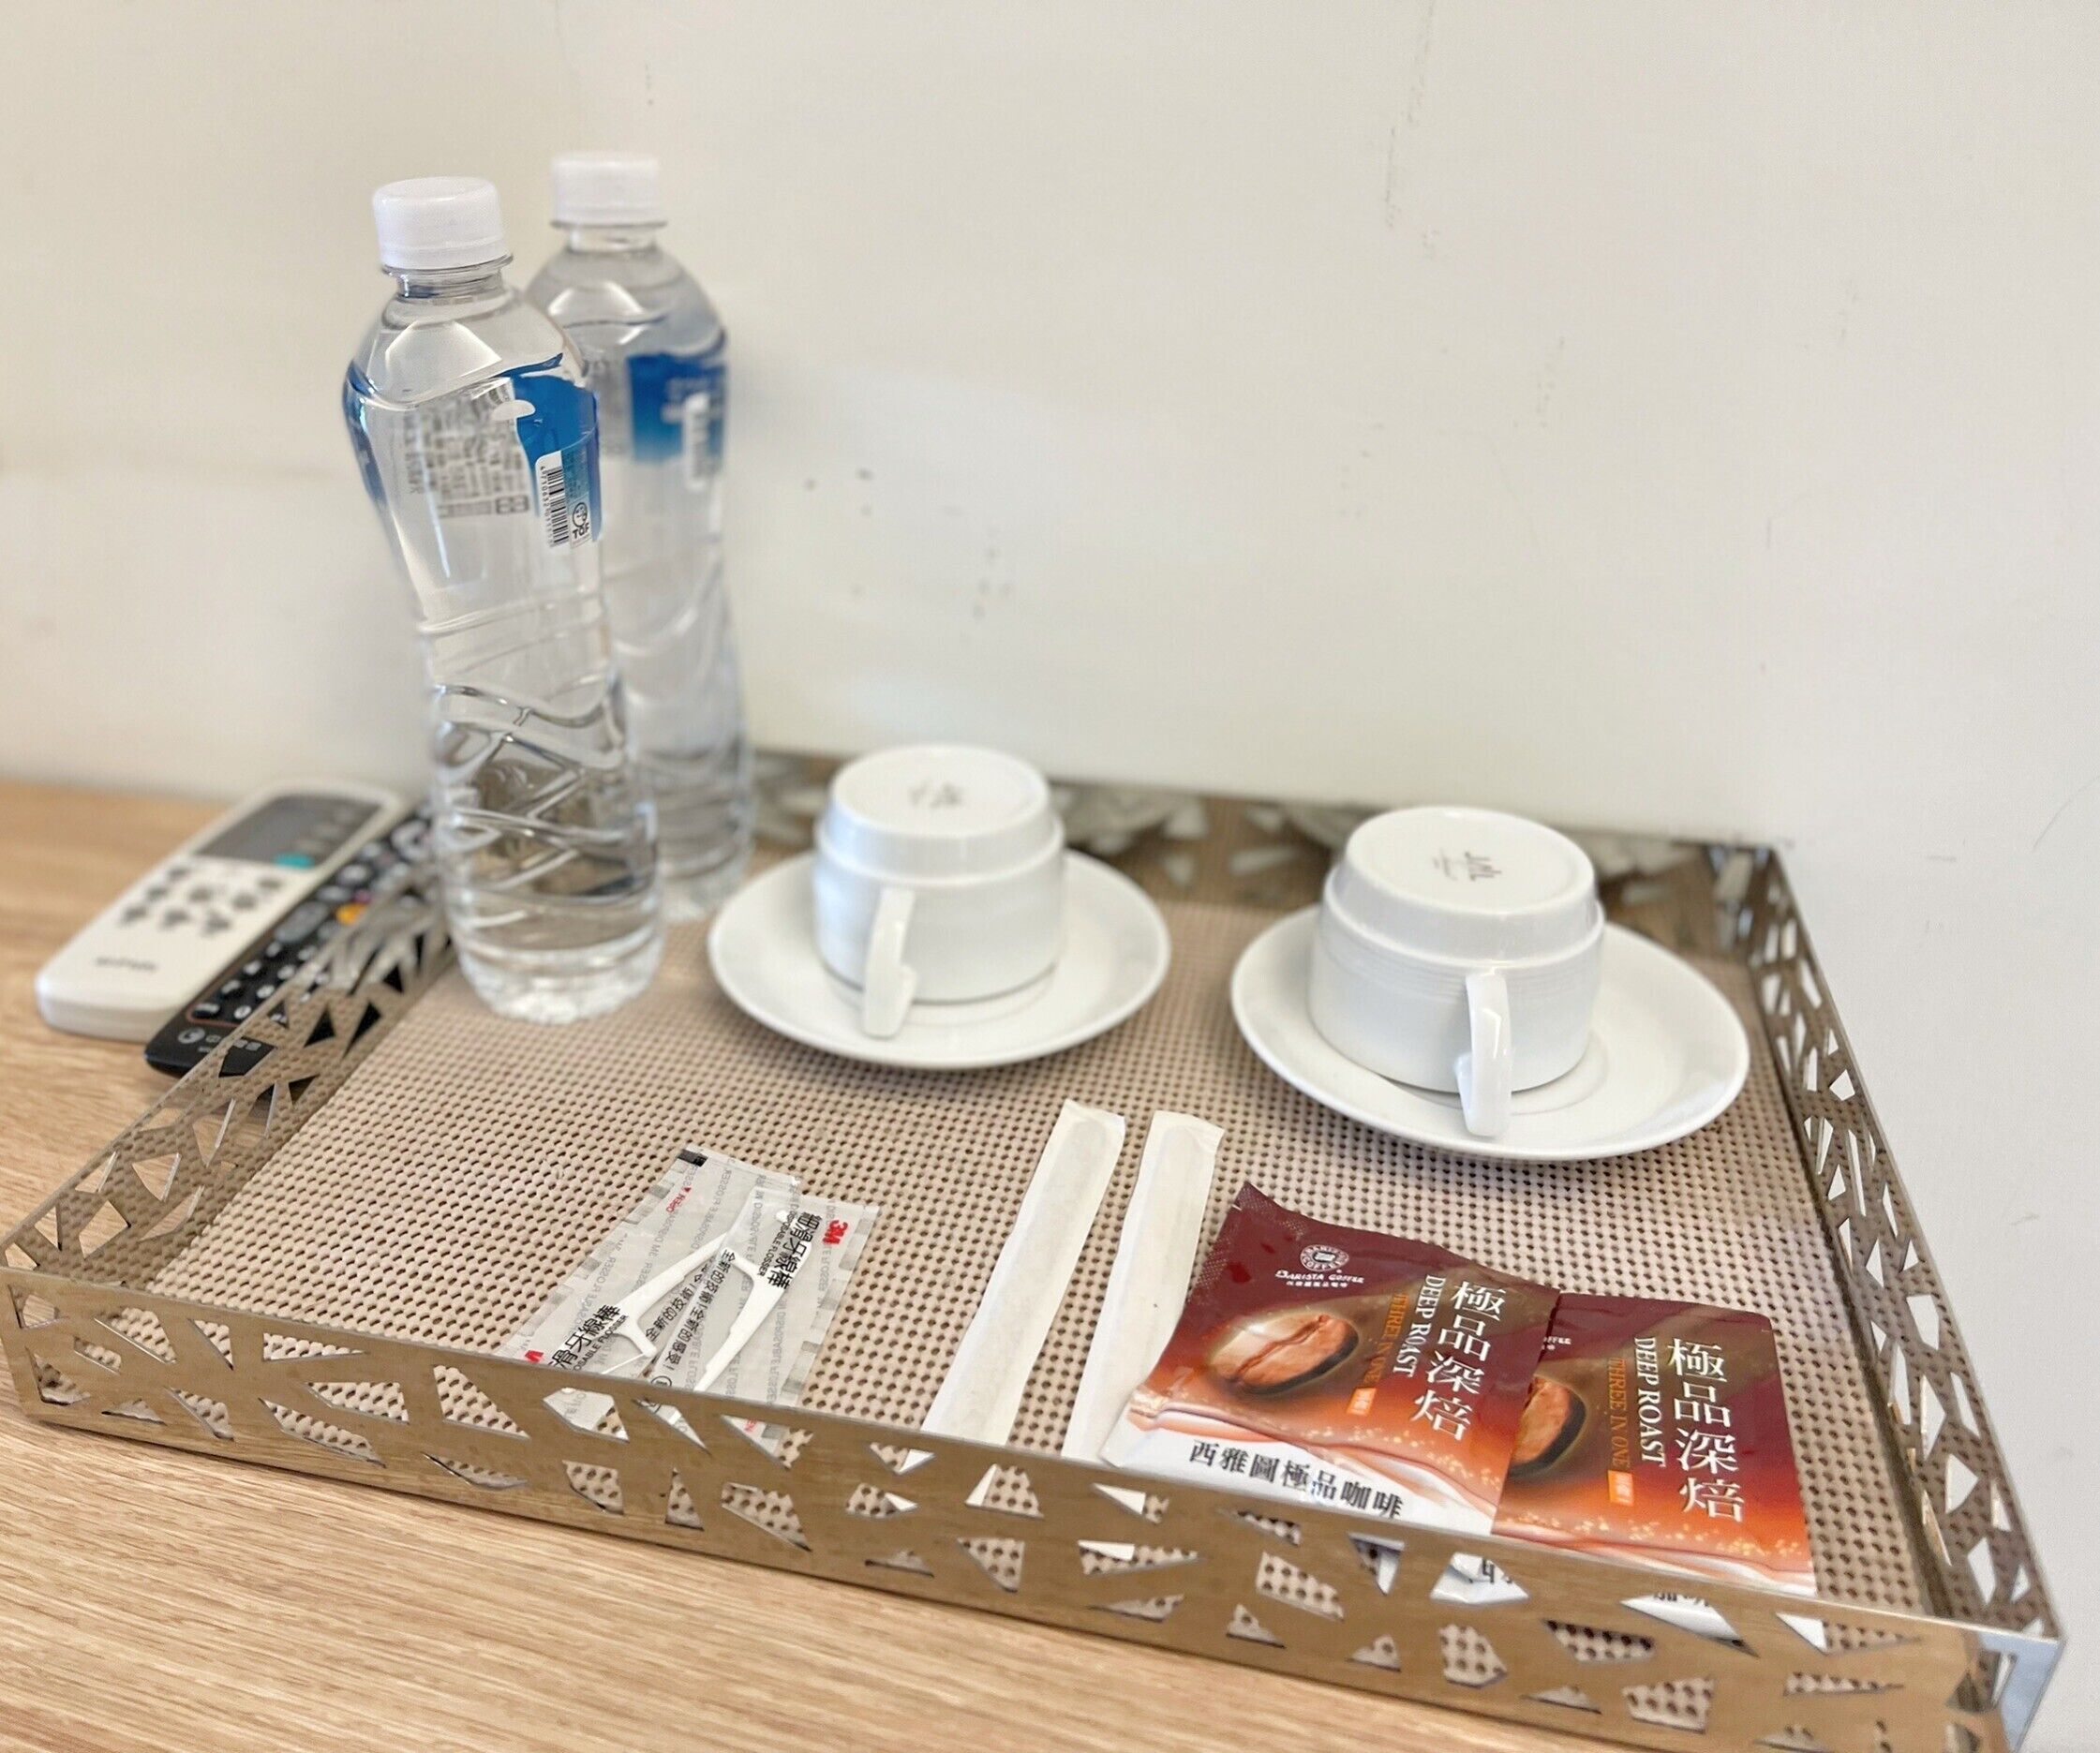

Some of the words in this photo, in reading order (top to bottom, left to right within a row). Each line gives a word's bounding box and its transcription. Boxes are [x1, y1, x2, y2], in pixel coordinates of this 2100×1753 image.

[767, 1211, 823, 1289] 細滑牙線棒
[823, 1219, 848, 1244] 3M
[1275, 1270, 1324, 1281] BARISTA
[1328, 1274, 1364, 1285] COFFEE
[1415, 1274, 1447, 1319] DEEP
[525, 1350, 544, 1364] M
[547, 1304, 620, 1369] 滑牙線棒
[573, 1344, 602, 1371] OSABLE
[600, 1314, 629, 1344] FLOSSER
[1393, 1322, 1432, 1378] ROAST
[1409, 1280, 1507, 1441] 極品深焙
[1543, 1335, 1571, 1344] FFEE
[1634, 1337, 1660, 1385] DEEP
[1608, 1359, 1627, 1411] THREE
[1610, 1415, 1628, 1434] IN
[1637, 1389, 1666, 1468] ROAST
[1667, 1338, 1745, 1523] 極品深焙
[1611, 1435, 1631, 1469] ONE
[1189, 1439, 1404, 1520] 西雅圖極品咖啡
